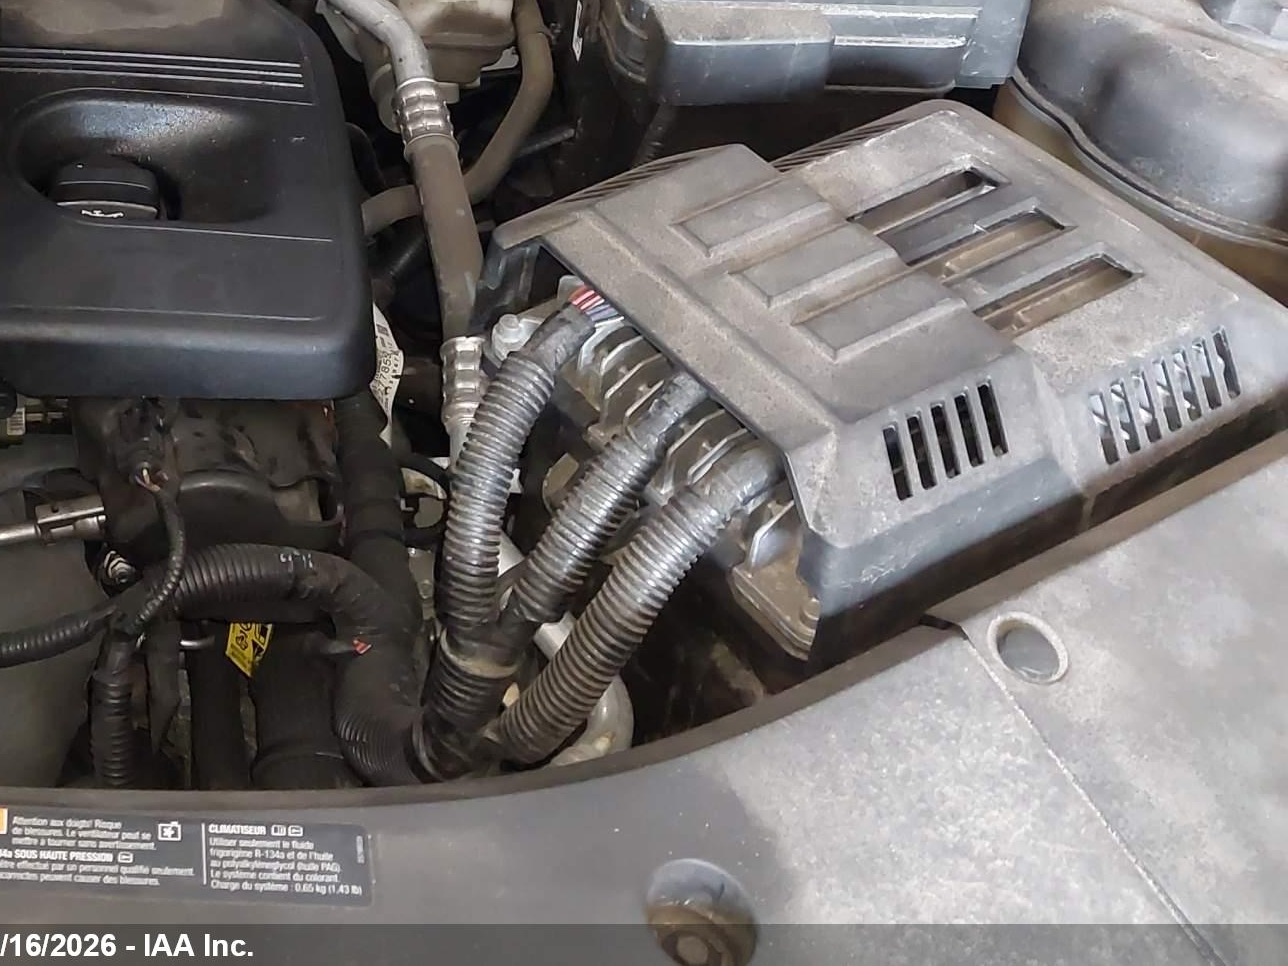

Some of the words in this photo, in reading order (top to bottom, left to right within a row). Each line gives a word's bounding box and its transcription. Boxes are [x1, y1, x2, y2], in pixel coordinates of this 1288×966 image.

[12, 816, 48, 826] Attention
[12, 827, 23, 835] de
[66, 829, 76, 837] Le
[208, 824, 266, 835] CLIMATISEUR
[14, 849, 38, 859] SOUS
[39, 850, 68, 860] HAUTE
[69, 851, 113, 862] PRESSION
[255, 849, 285, 859] R-134a
[286, 851, 295, 860] et
[296, 851, 307, 860] de
[210, 869, 220, 878] Le
[292, 872, 303, 882] du
[211, 880, 240, 892] Charge
[242, 881, 252, 891] du
[315, 883, 327, 895] kg
